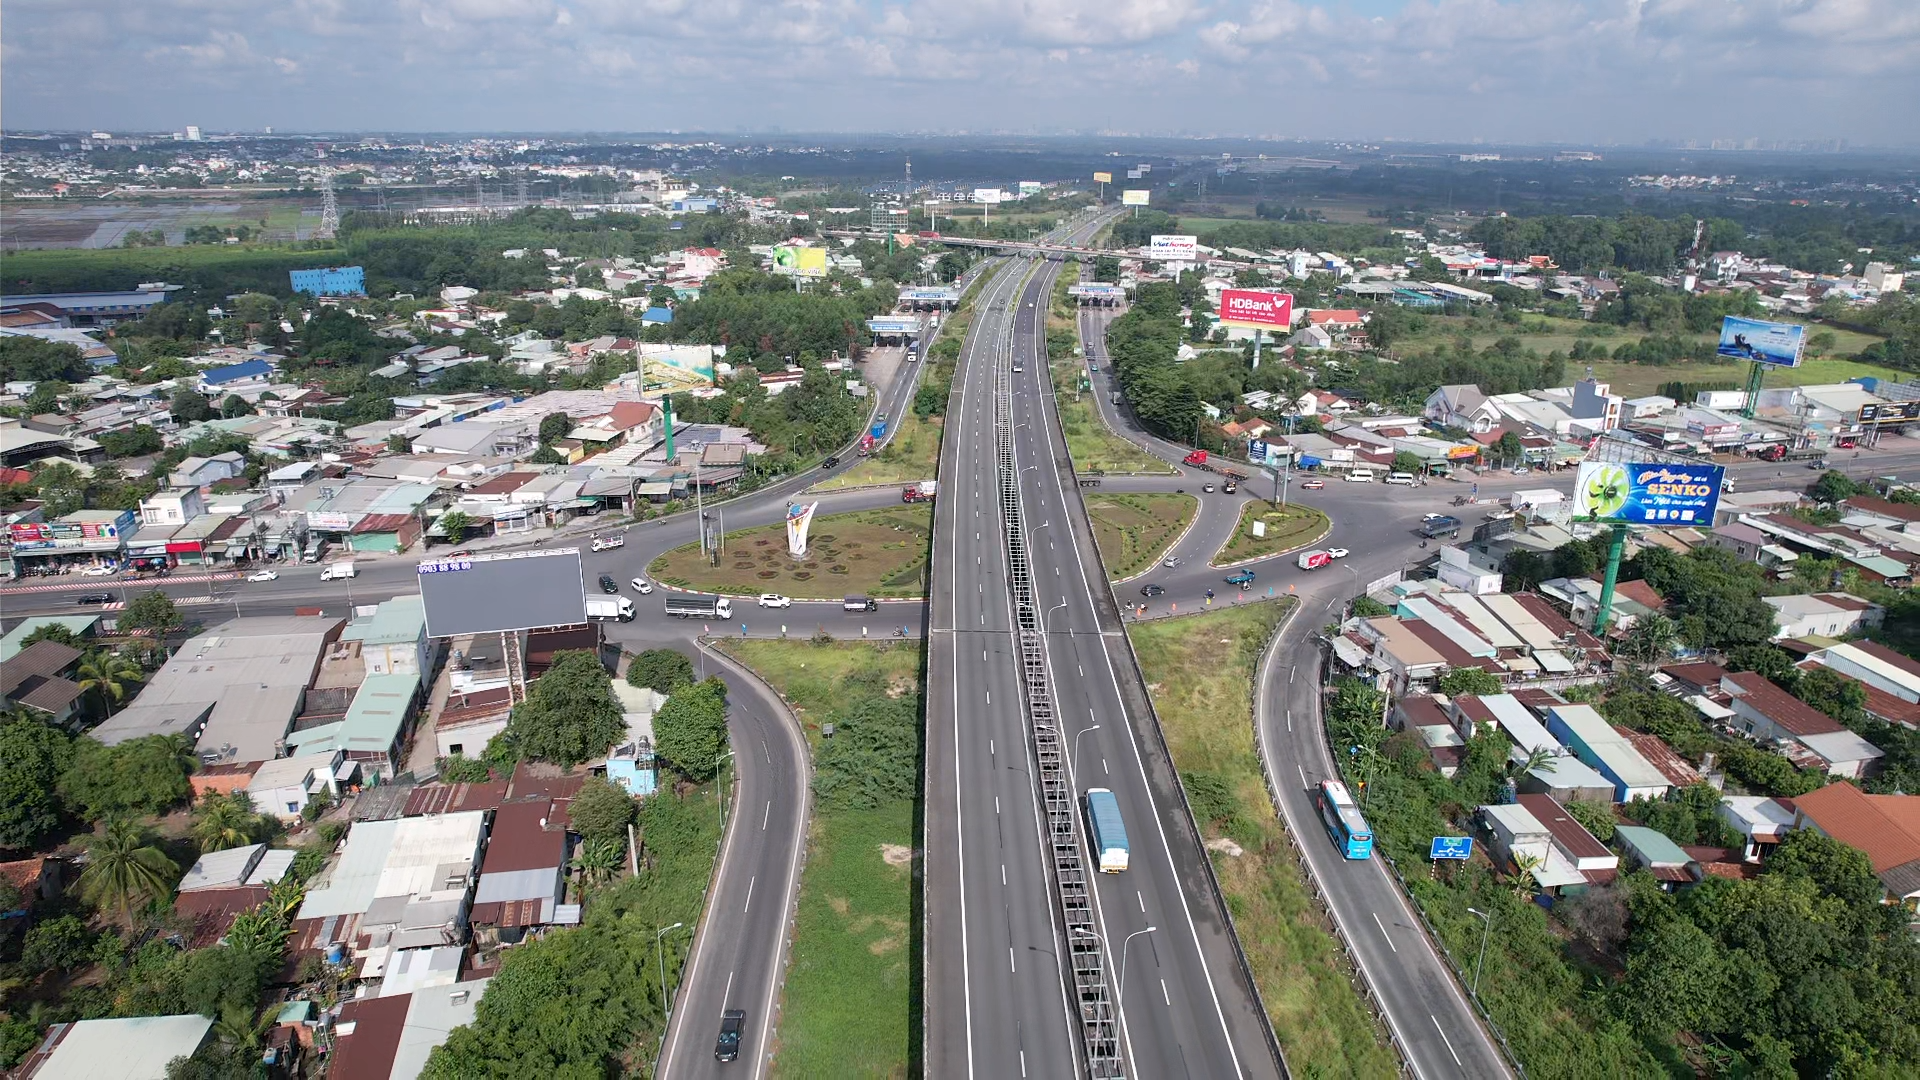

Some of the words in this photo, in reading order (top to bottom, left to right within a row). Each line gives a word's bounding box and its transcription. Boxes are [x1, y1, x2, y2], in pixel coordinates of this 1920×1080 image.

[1229, 297, 1273, 311] HDBank
[1647, 483, 1711, 497] SENKO
[418, 564, 437, 573] 0903
[439, 563, 449, 571] 88
[450, 562, 460, 571] 98
